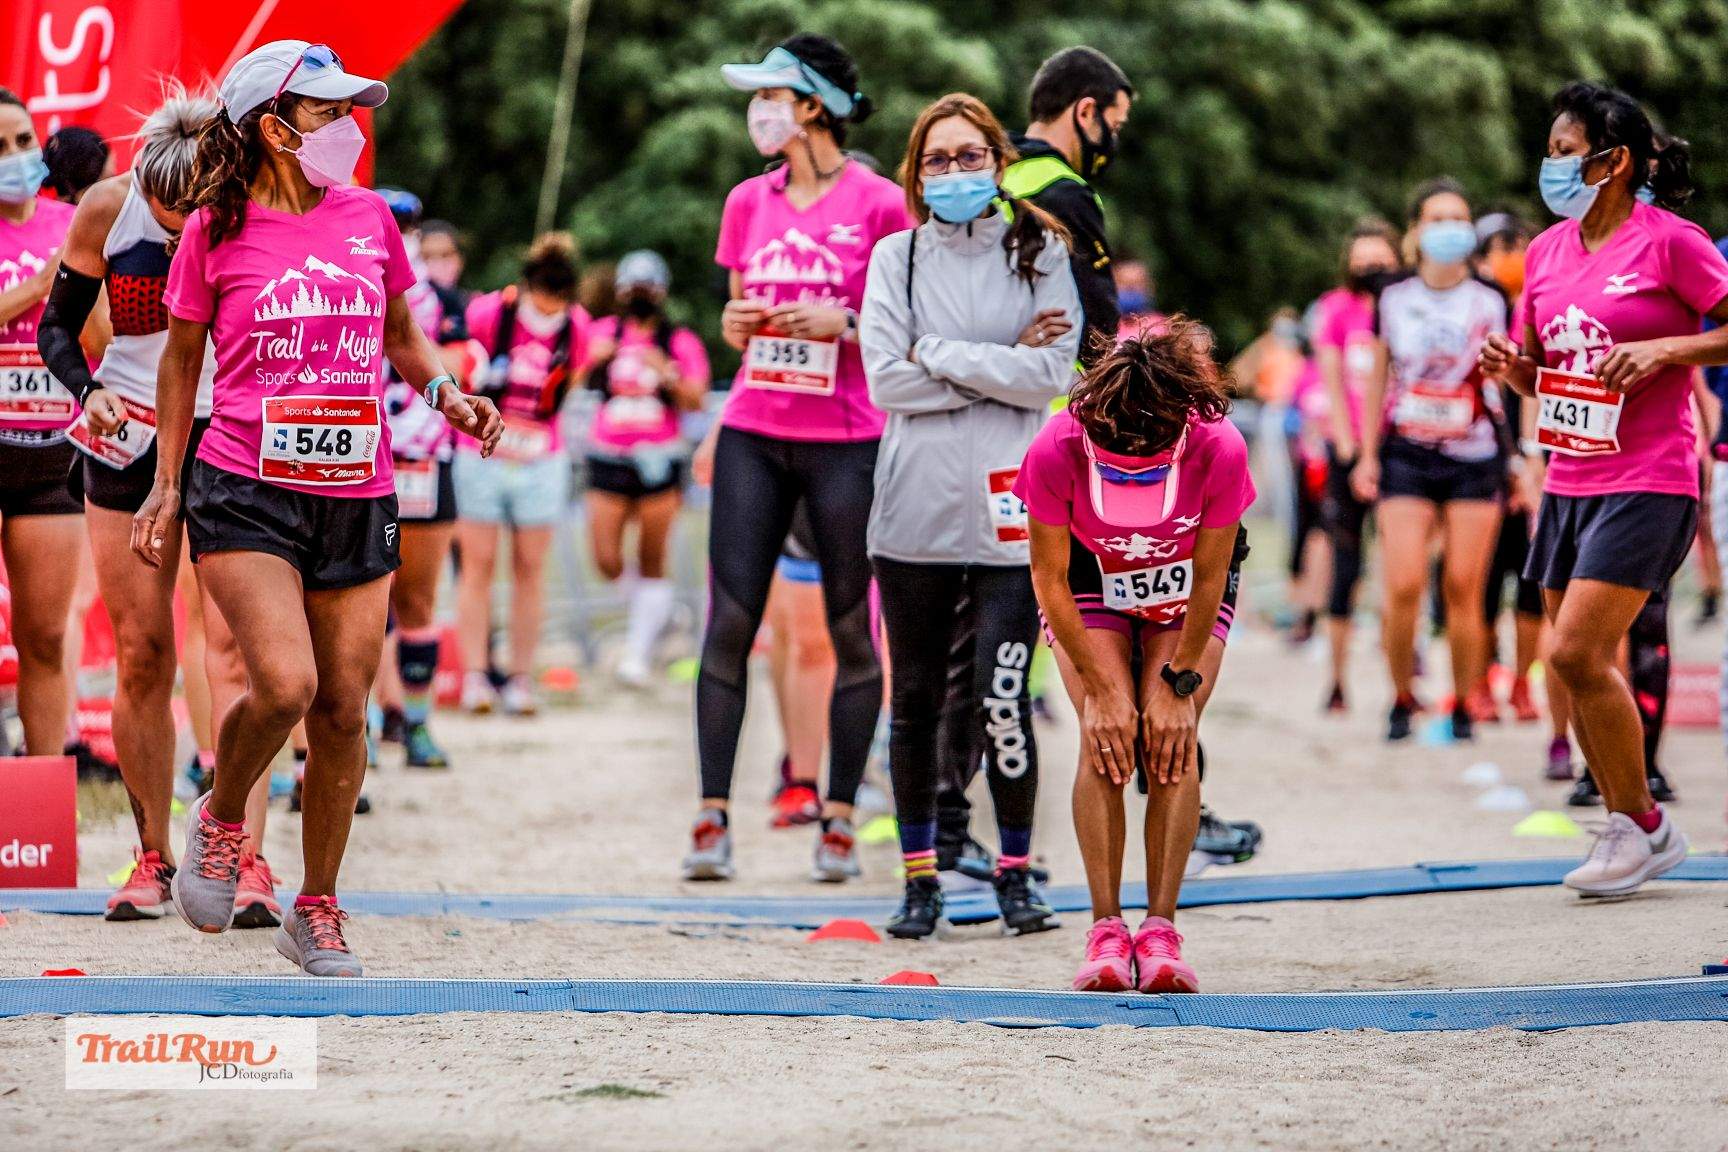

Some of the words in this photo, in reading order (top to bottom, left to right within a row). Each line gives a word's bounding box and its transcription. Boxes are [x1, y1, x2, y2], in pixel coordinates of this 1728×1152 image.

[250, 320, 304, 361] Trail
[771, 343, 809, 365] 355
[9, 371, 50, 393] 361
[284, 406, 312, 416] Sports
[323, 407, 362, 417] Santander
[1553, 401, 1590, 429] 431
[296, 427, 352, 456] 548
[1131, 565, 1186, 599] 549
[983, 641, 1029, 778] adidas
[0, 838, 53, 868] der
